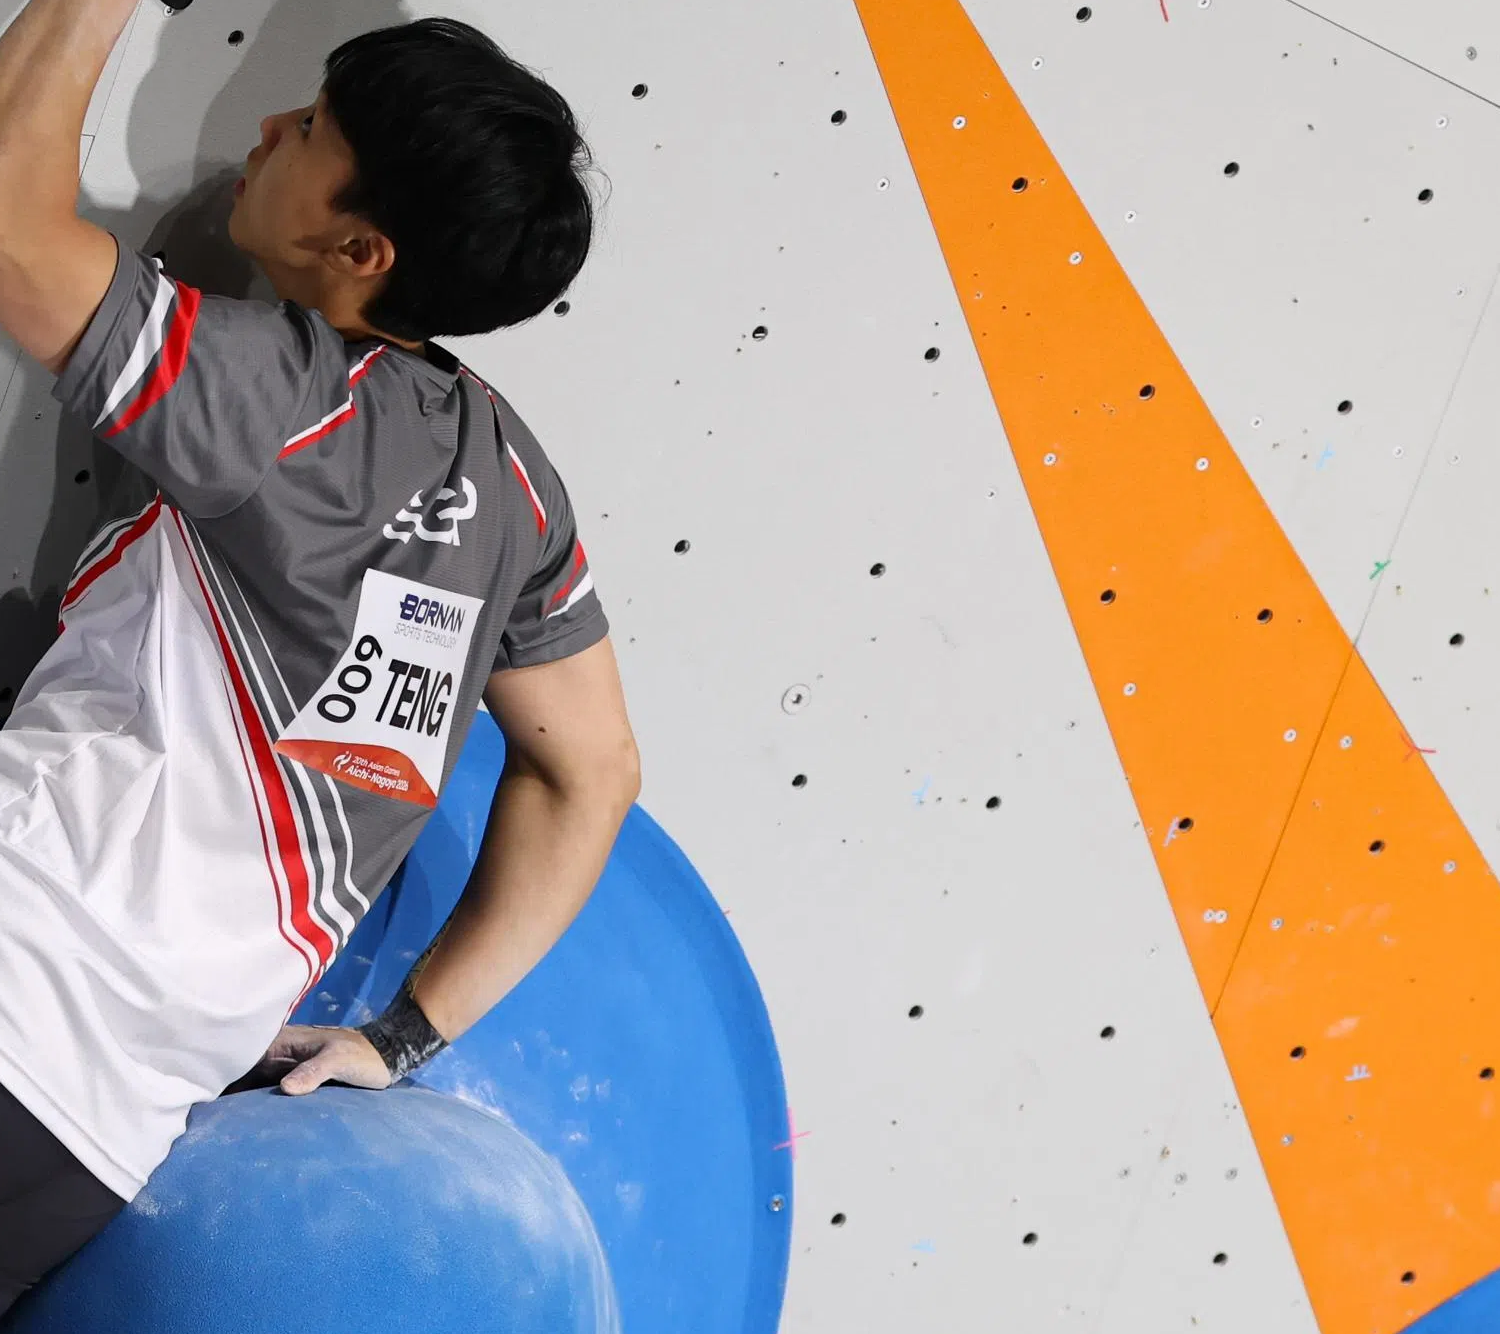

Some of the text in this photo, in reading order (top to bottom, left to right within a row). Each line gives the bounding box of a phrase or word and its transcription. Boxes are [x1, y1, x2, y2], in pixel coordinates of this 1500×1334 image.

[394, 622, 423, 641] SPORTS
[399, 593, 466, 634] BORNAN
[375, 658, 453, 737] TENG
